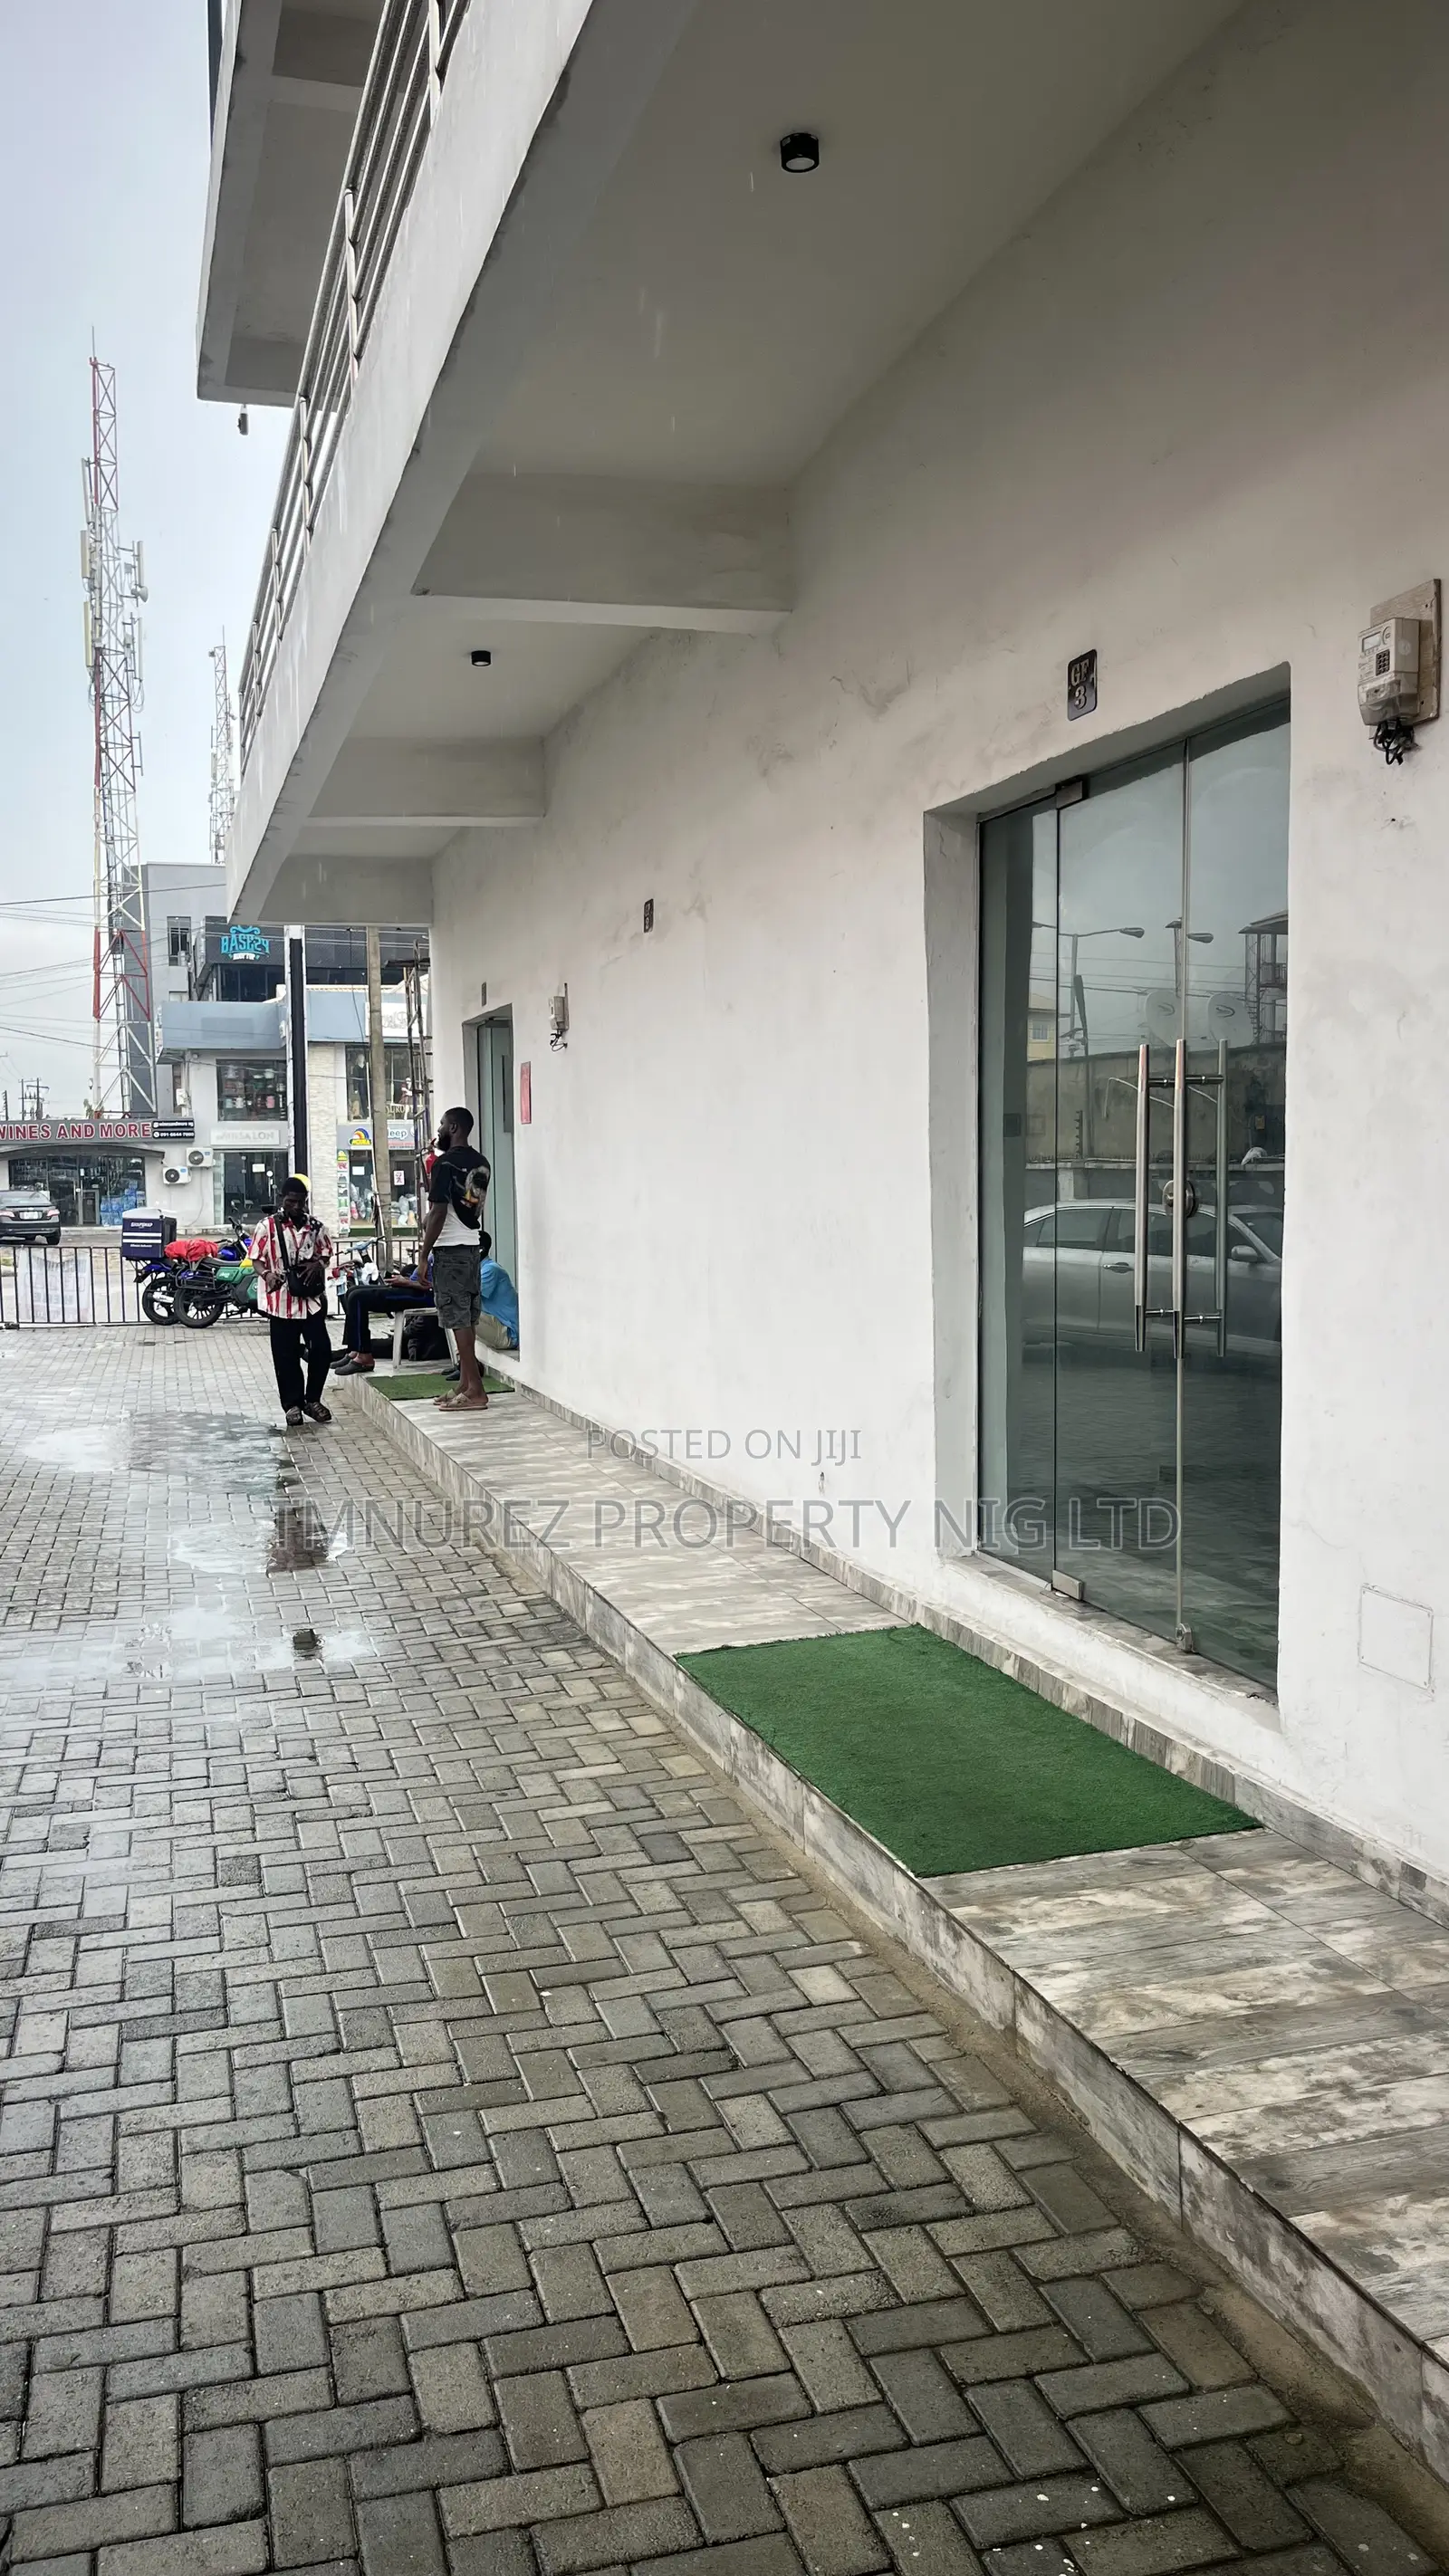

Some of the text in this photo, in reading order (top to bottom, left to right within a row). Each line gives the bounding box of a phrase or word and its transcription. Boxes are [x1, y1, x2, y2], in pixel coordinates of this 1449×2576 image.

[1075, 685, 1086, 710] 3
[56, 1123, 95, 1140] AND
[99, 1122, 152, 1139] MORE
